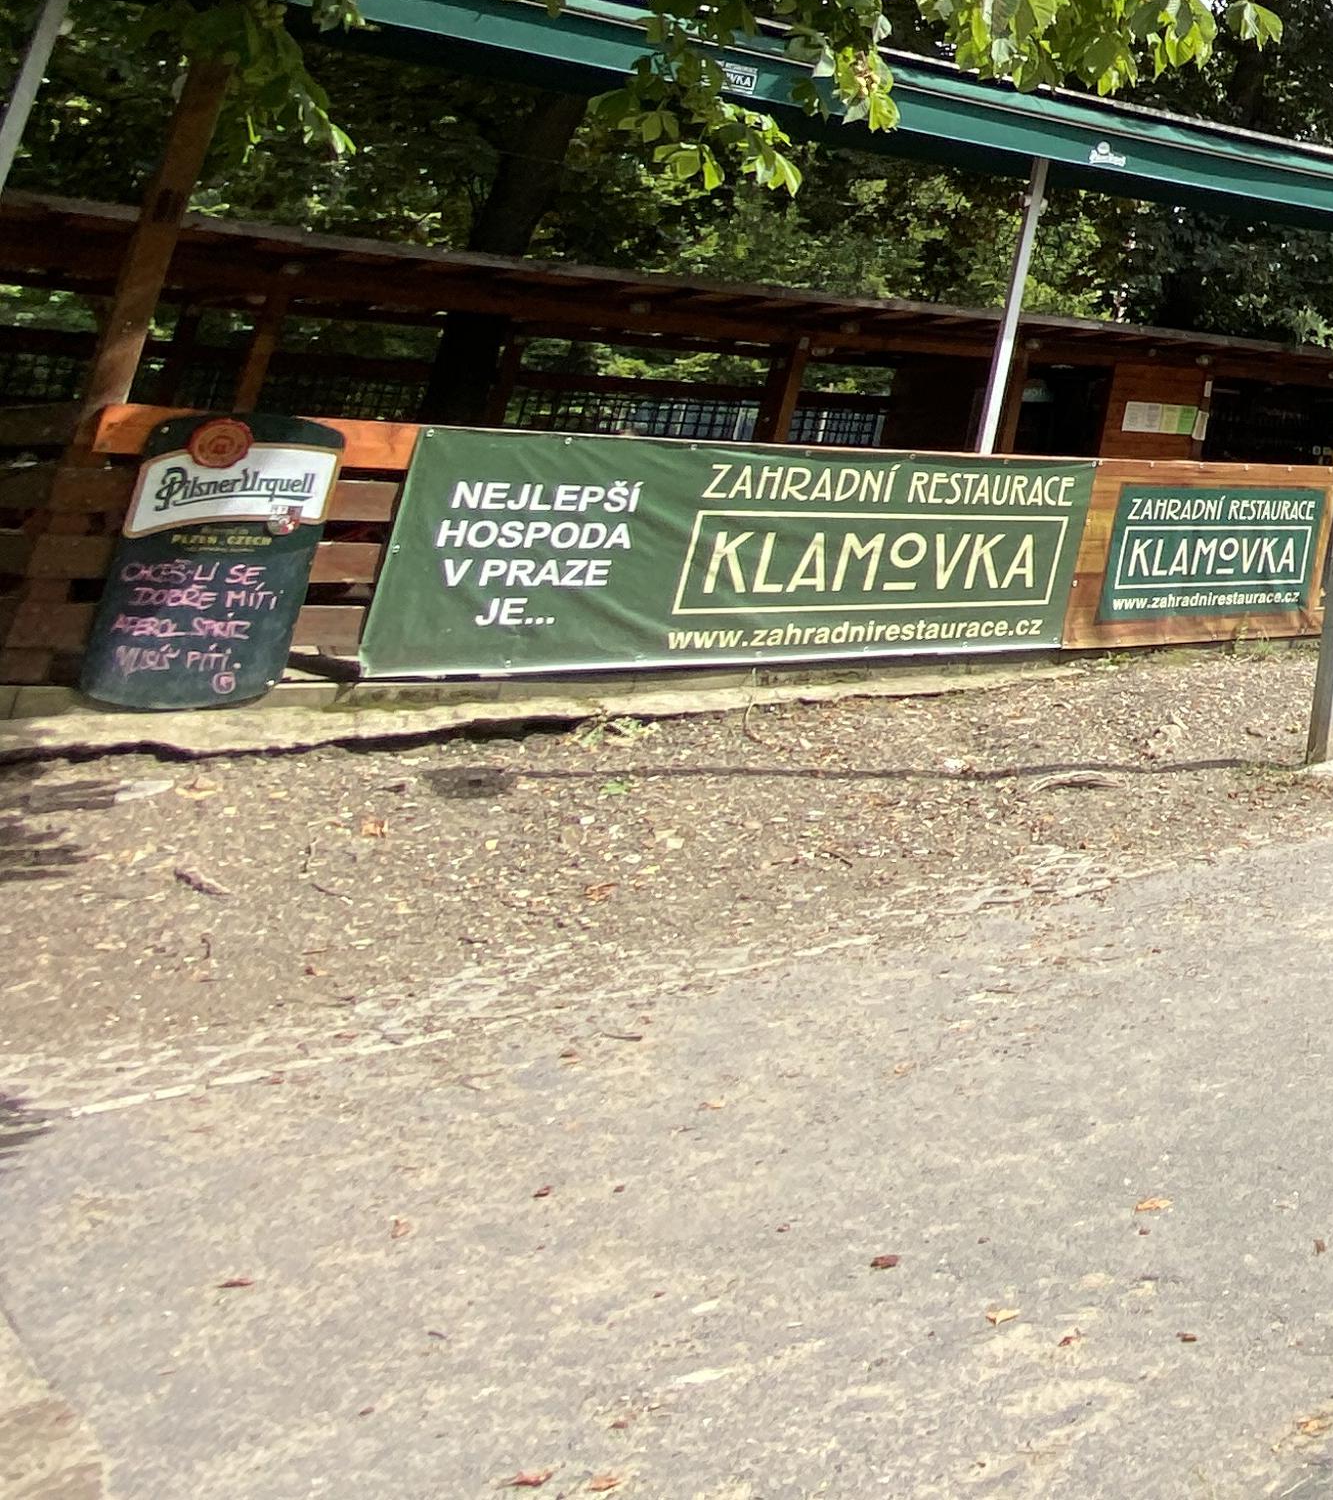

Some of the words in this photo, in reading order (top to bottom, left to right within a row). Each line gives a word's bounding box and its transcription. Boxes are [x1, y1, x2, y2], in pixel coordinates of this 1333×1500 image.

[155, 466, 242, 512] Pilsner
[240, 469, 316, 502] Urquell
[451, 480, 644, 513] NEJLEPŠÍ
[702, 464, 899, 503] ZAHRADNÍ
[908, 471, 1075, 506] RESTAURACE
[1127, 495, 1226, 520] ZAHRADNÍ
[1229, 499, 1316, 520] RESTAURACE
[436, 520, 631, 549] HOSPODA
[702, 530, 1036, 593] KLAMOVKA
[1127, 536, 1295, 577] KLAMOVKA
[444, 559, 473, 587] V
[478, 559, 612, 587] PRAZE
[474, 597, 555, 626] JE...
[1112, 590, 1300, 611] www.zahradnirestaurace.cz
[668, 617, 1042, 649] www.zahradnirestaurace.cz
